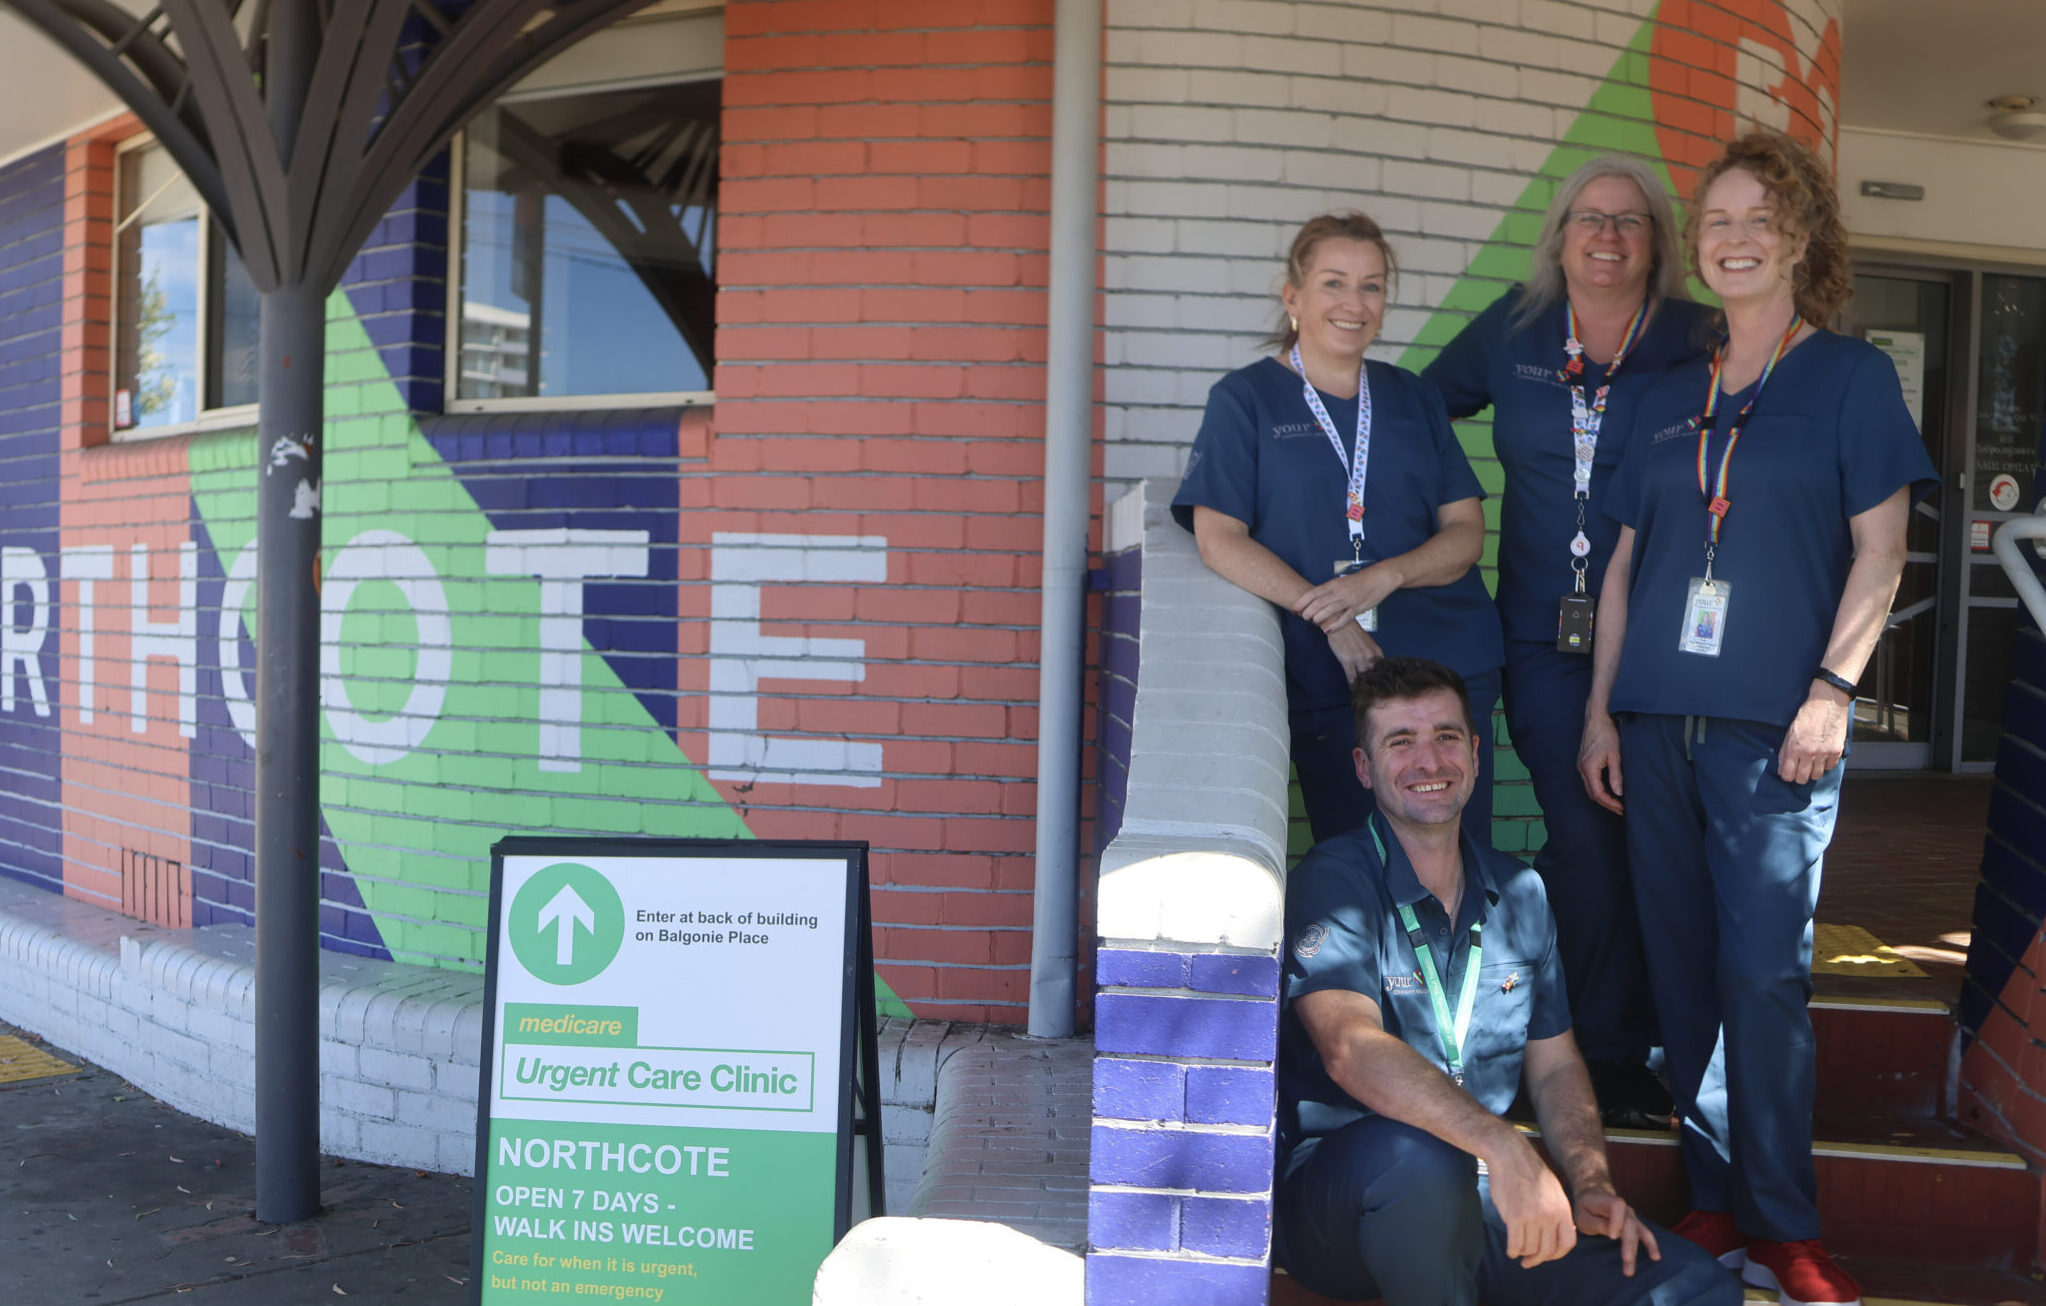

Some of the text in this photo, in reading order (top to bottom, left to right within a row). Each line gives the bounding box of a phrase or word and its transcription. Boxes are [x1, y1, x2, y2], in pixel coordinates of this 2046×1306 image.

[1272, 424, 1310, 439] your
[636, 910, 818, 929] Enter at back of building
[635, 930, 769, 945] on Balgonie Place
[1383, 975, 1412, 991] your
[518, 1014, 622, 1036] medicare
[515, 1057, 798, 1095] Urgent Care Clinic
[498, 1137, 730, 1177] NORTHCOTE
[495, 1185, 564, 1209] OPEN
[572, 1189, 585, 1209] 7
[592, 1190, 659, 1214] DAYS
[494, 1216, 754, 1250] WALK INS WELCOME
[492, 1250, 698, 1279] Care for when it is urgent,
[491, 1275, 664, 1302] but not an emergency
